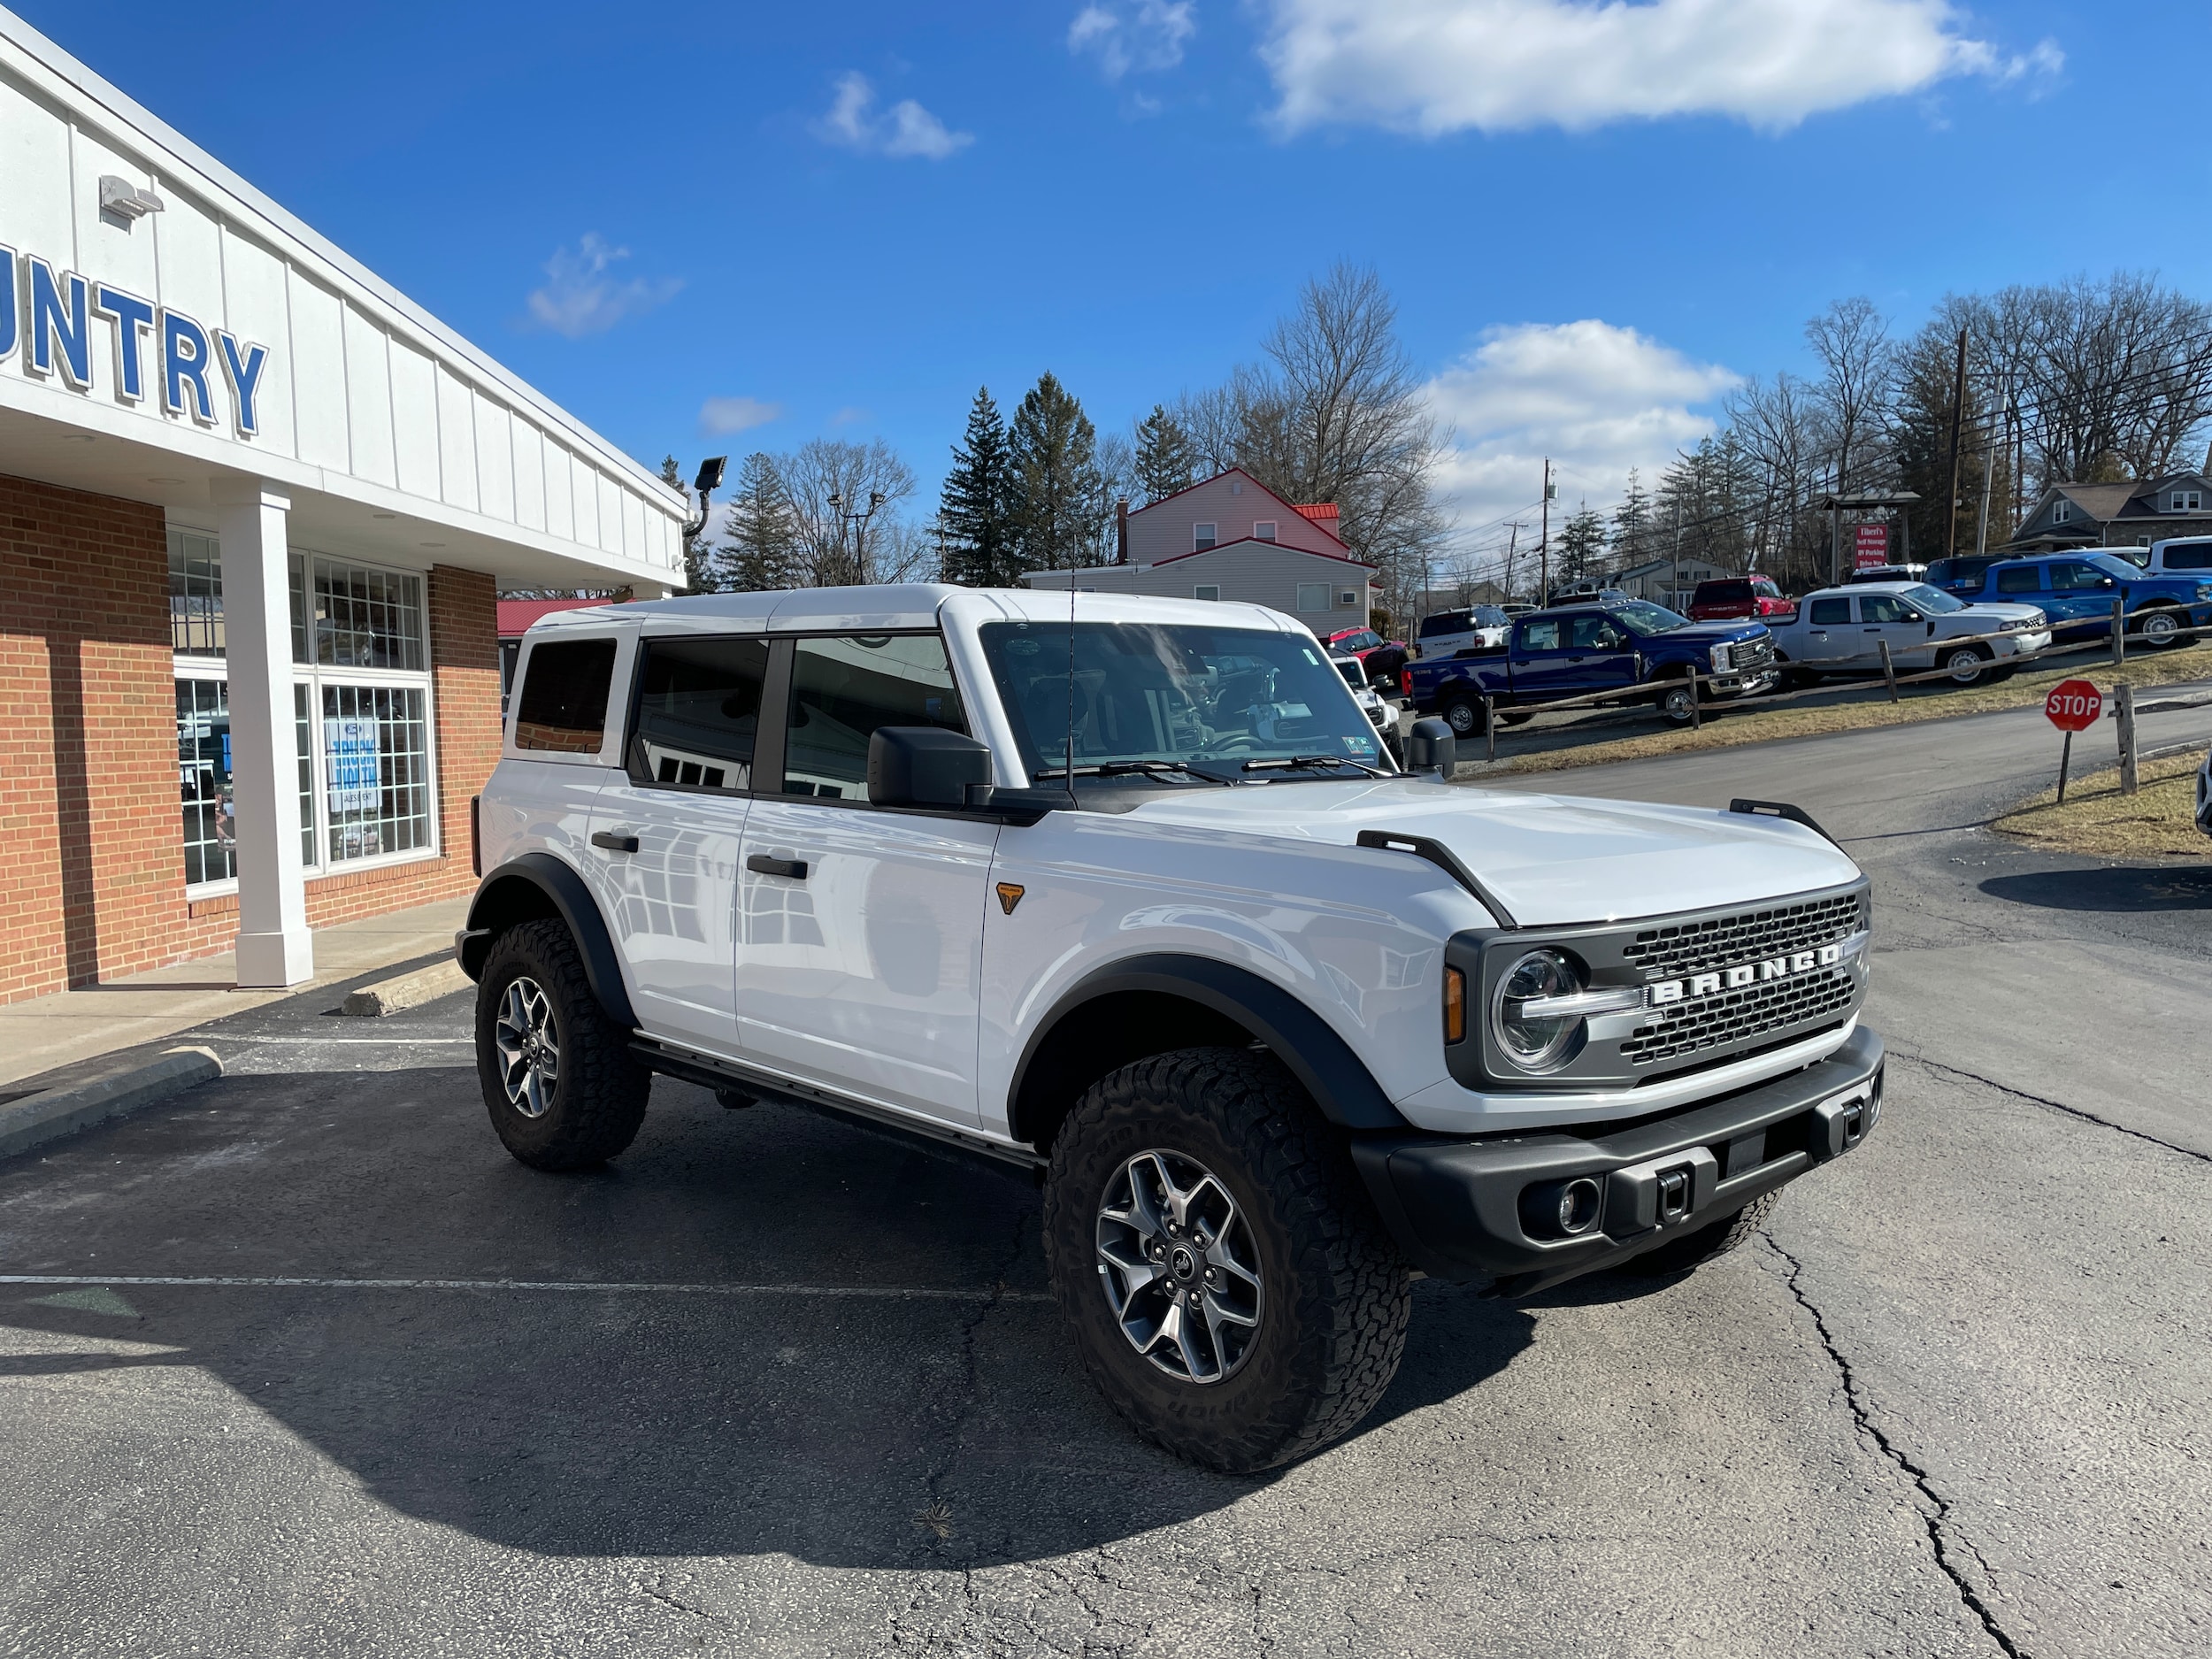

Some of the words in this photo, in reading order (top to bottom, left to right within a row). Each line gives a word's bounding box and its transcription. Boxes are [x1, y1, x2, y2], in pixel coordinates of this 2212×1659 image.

[2048, 695, 2100, 716] STOP
[333, 740, 375, 766] TRUCK
[1650, 944, 1839, 1005] BRONCO
